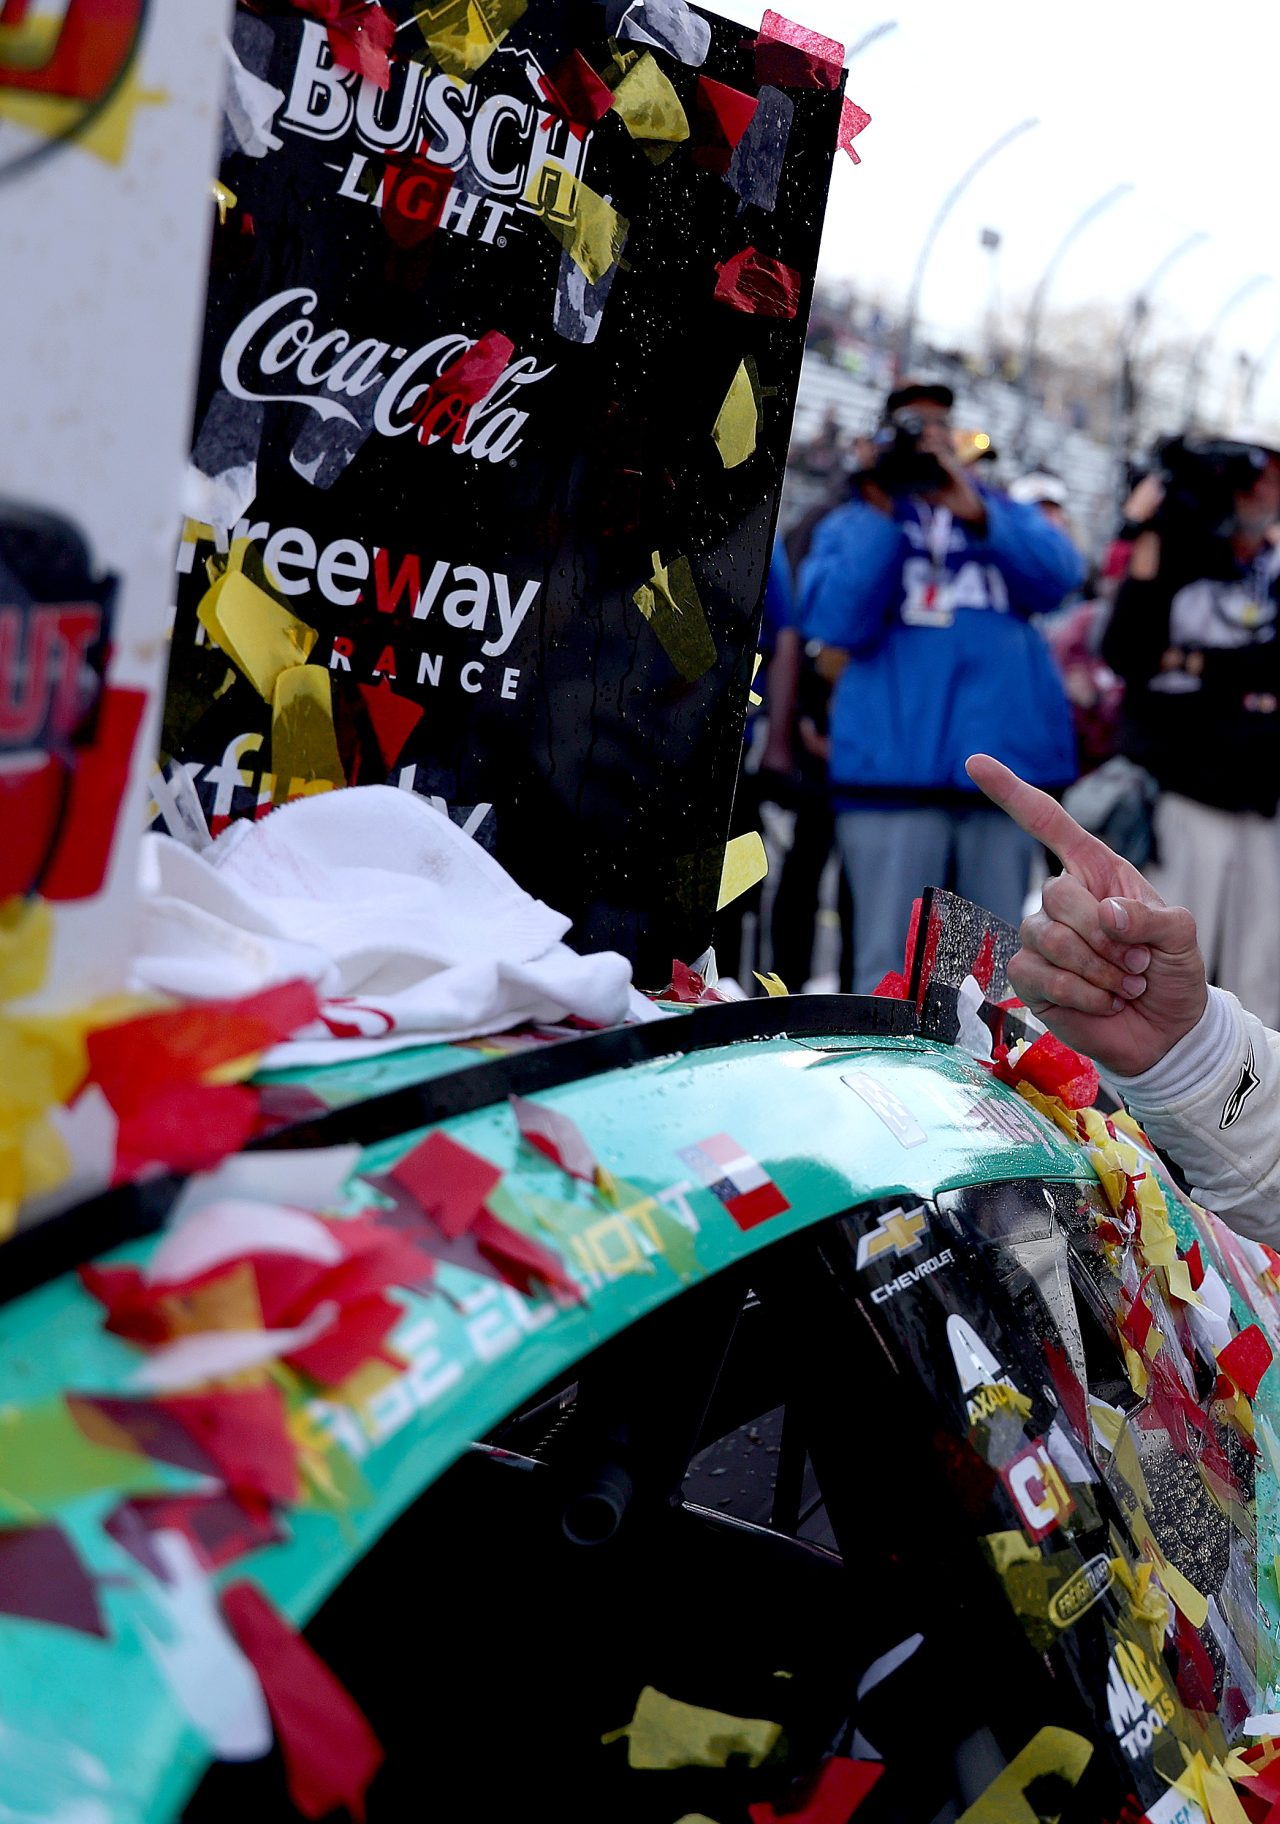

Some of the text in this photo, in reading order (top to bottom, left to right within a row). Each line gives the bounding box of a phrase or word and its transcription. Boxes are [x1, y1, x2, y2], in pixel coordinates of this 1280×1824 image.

[279, 18, 593, 226] BUSCH
[336, 152, 514, 244] LIGHT
[221, 287, 556, 464] Coca-Cola
[870, 1248, 955, 1305] CHEVROLET
